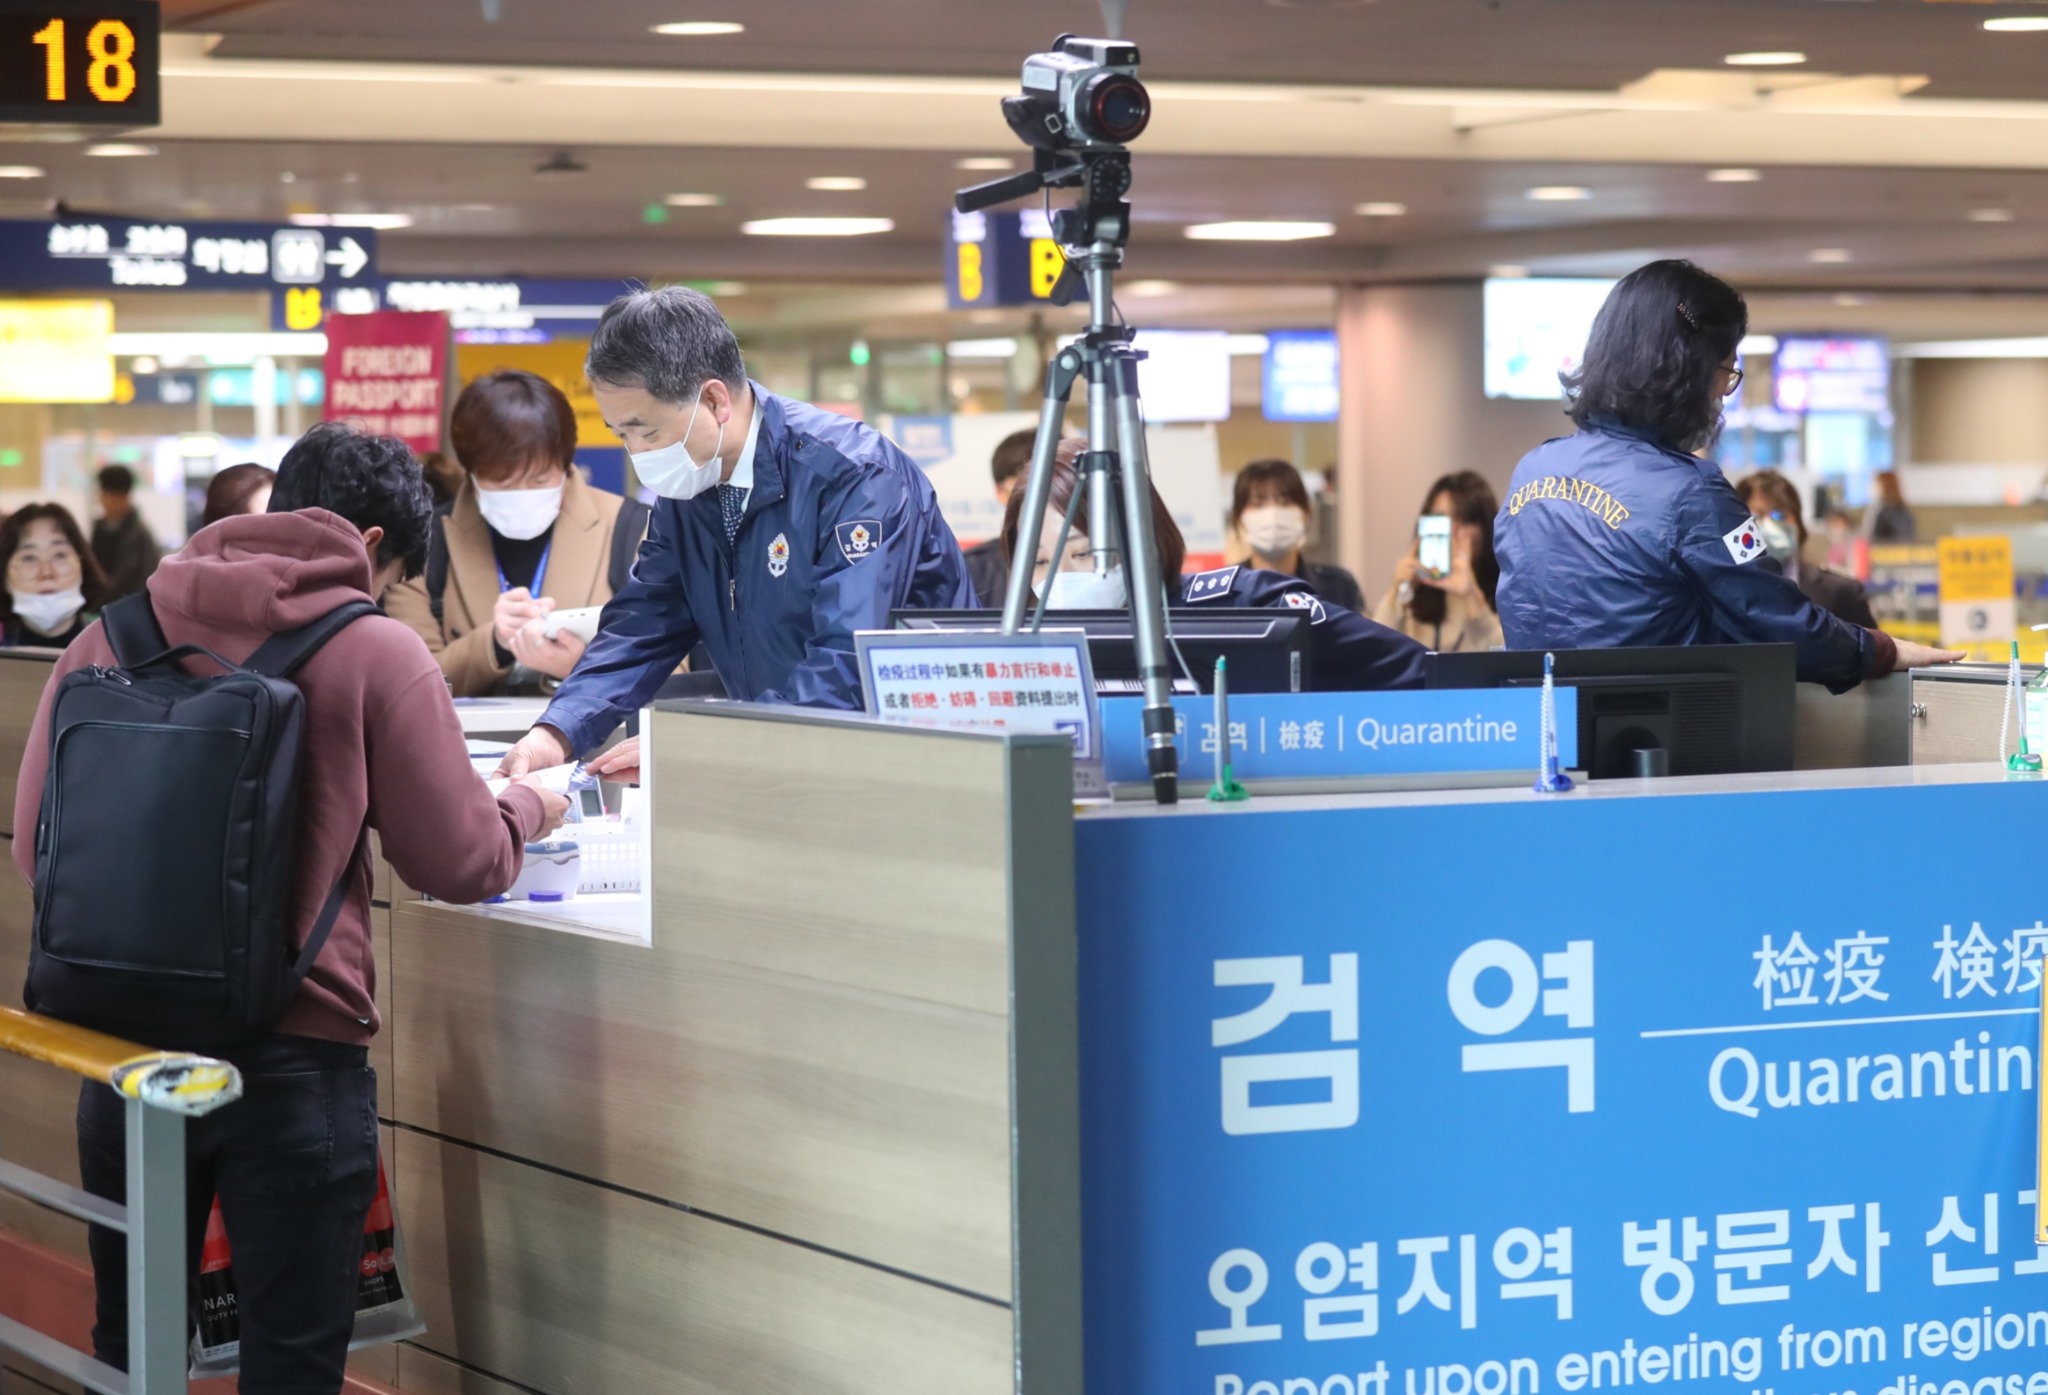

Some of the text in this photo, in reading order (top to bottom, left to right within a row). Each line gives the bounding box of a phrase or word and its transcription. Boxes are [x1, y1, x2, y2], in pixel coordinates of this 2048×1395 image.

[33, 18, 136, 102] 18
[332, 378, 439, 410] PASSPORT
[342, 346, 433, 376] FOREIGN
[1509, 476, 1630, 531] QUARANTINE
[1356, 714, 1518, 749] Quarantine
[1752, 930, 1890, 1011] 检疫
[1195, 1226, 1574, 1347] 오염지역
[1622, 1202, 1891, 1316] 방문자
[1406, 1357, 1539, 1395] upon
[1555, 1332, 1763, 1392] entering
[1779, 1323, 1887, 1371] from
[1903, 1306, 2048, 1362] region
